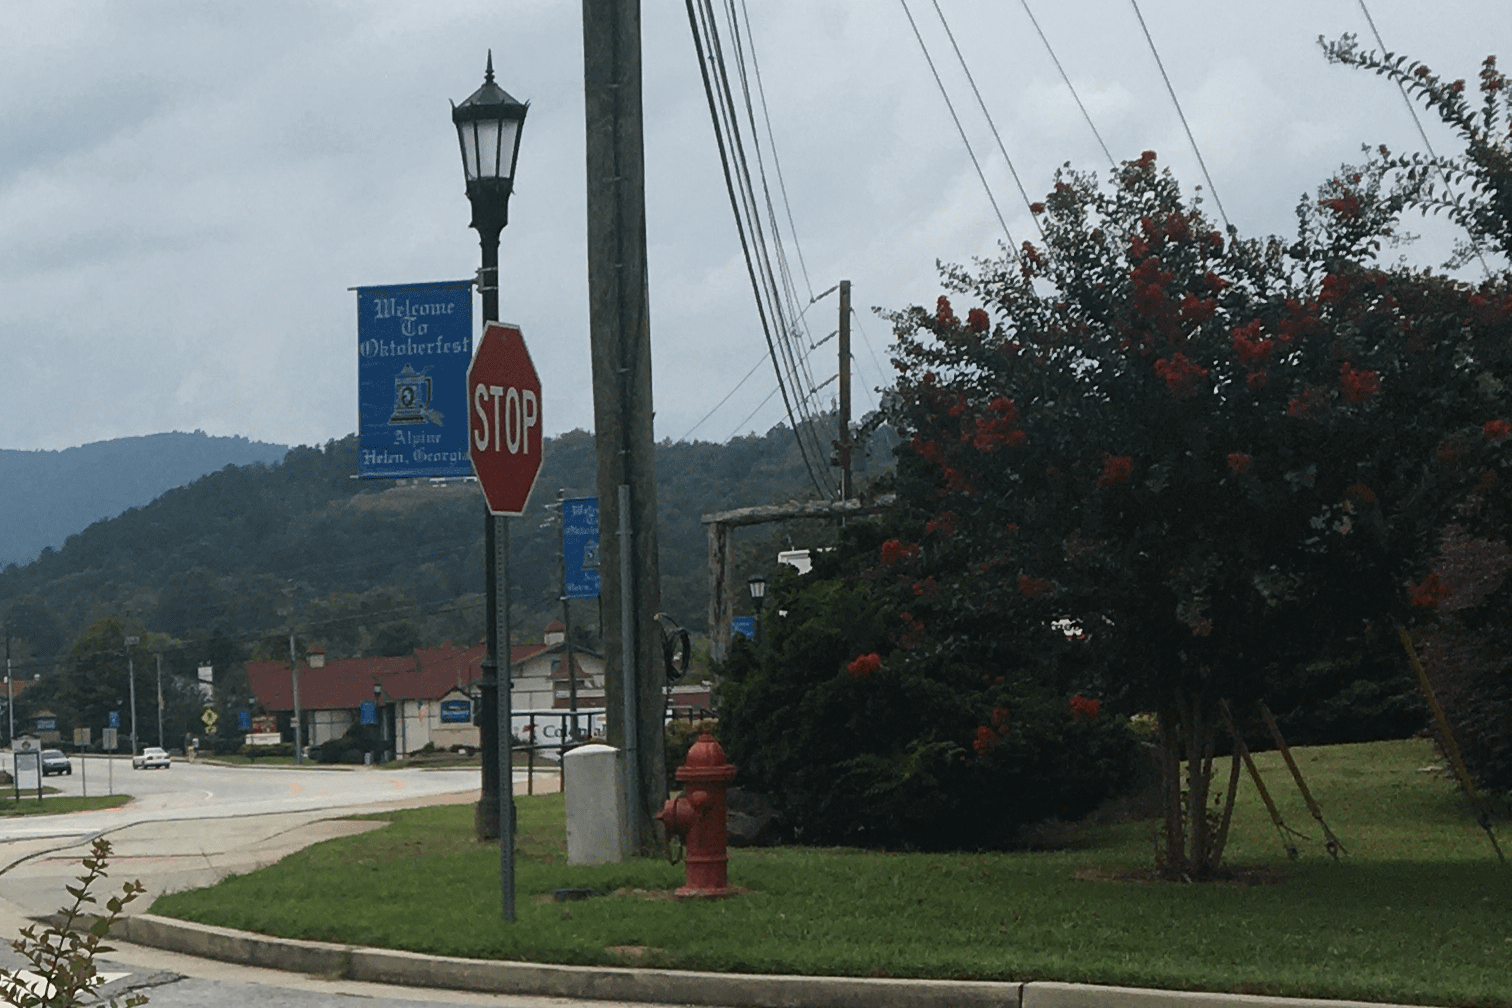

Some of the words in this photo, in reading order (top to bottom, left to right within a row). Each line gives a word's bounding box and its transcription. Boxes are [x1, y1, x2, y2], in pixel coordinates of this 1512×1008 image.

[374, 298, 455, 318] Welcome
[401, 316, 429, 336] To
[360, 336, 469, 358] Oktoberfest
[474, 383, 538, 454] STOP
[393, 430, 441, 448] Alpine
